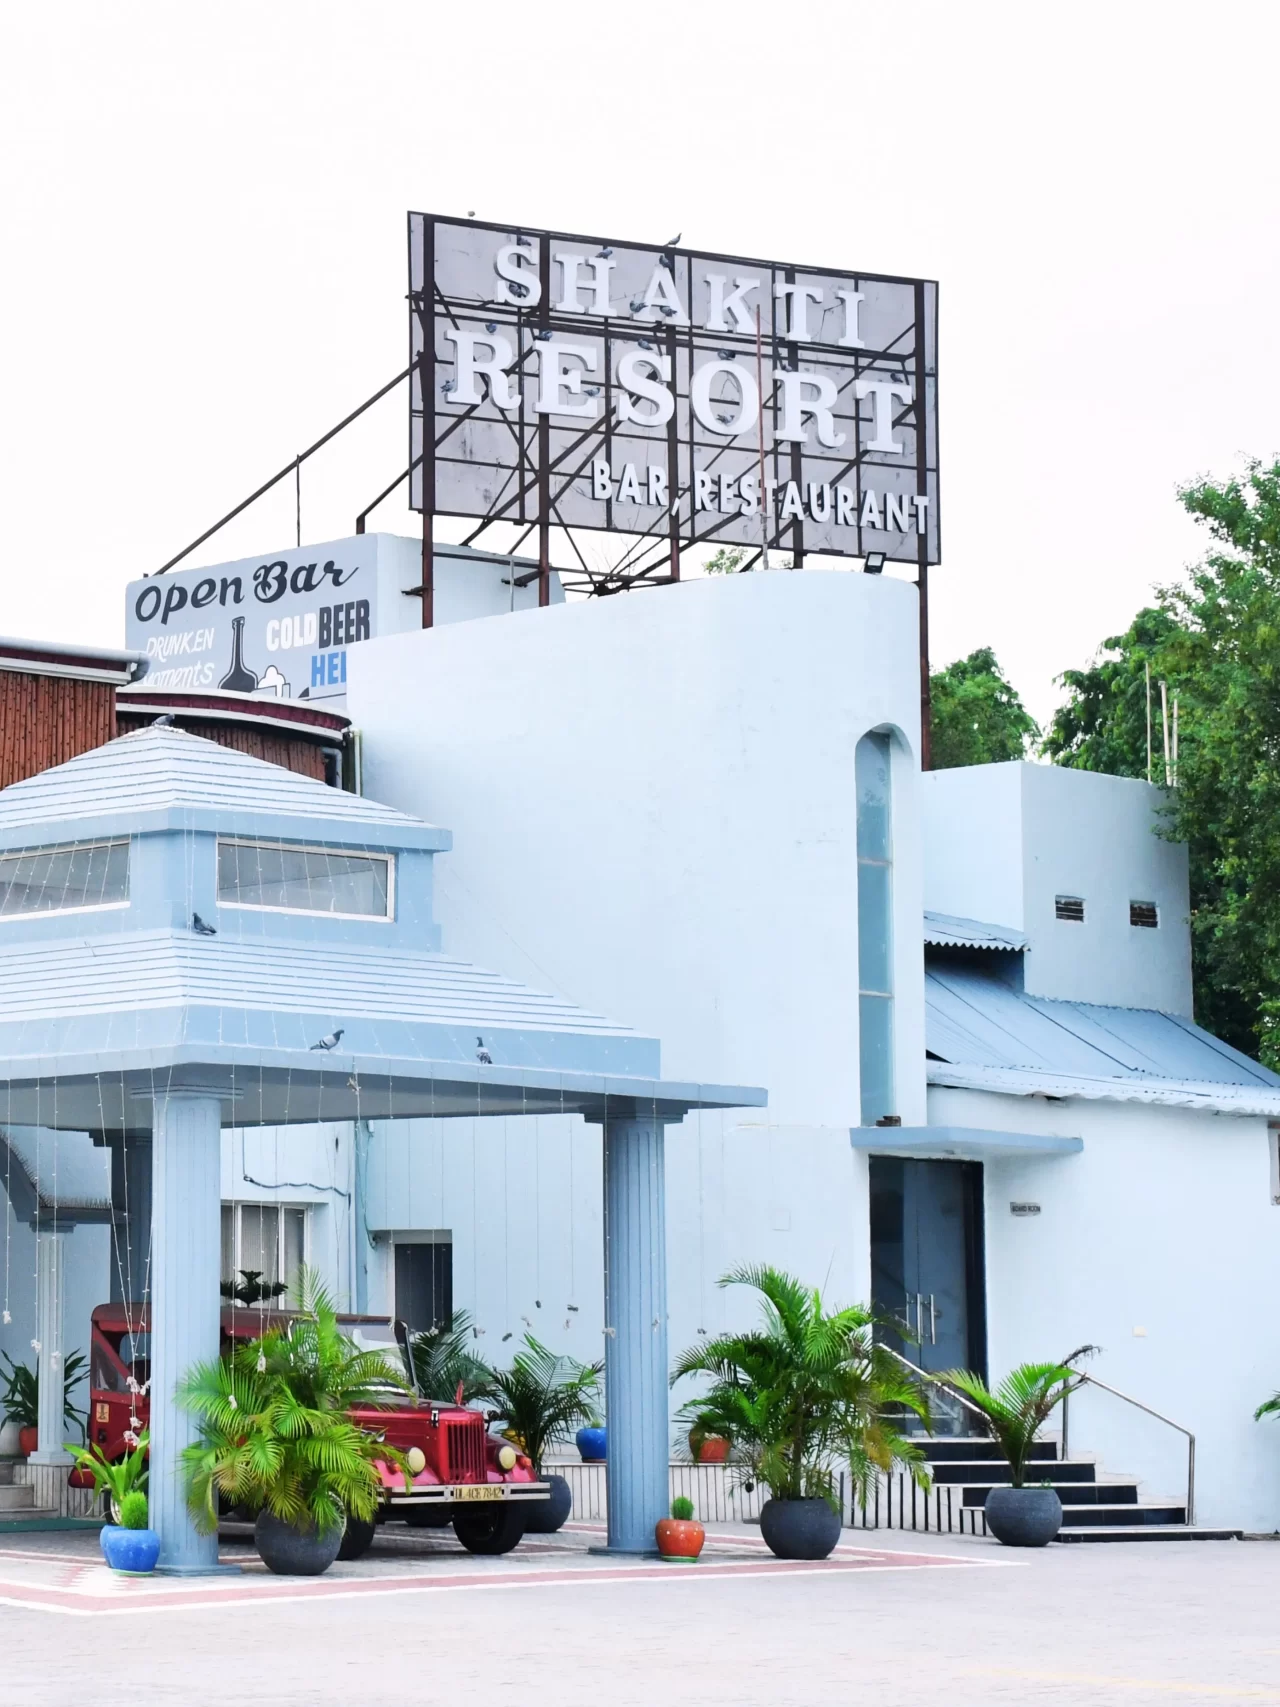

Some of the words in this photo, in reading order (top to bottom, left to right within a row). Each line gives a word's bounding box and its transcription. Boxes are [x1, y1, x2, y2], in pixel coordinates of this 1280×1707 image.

[493, 245, 866, 350] SHAKTI
[443, 328, 913, 455] RESORT
[693, 469, 930, 535] RESTAURANT
[135, 576, 245, 625] Open
[253, 560, 360, 603] Bar
[146, 627, 216, 663] DRUNKEN
[266, 612, 318, 652] COLD
[318, 599, 370, 649] BEER
